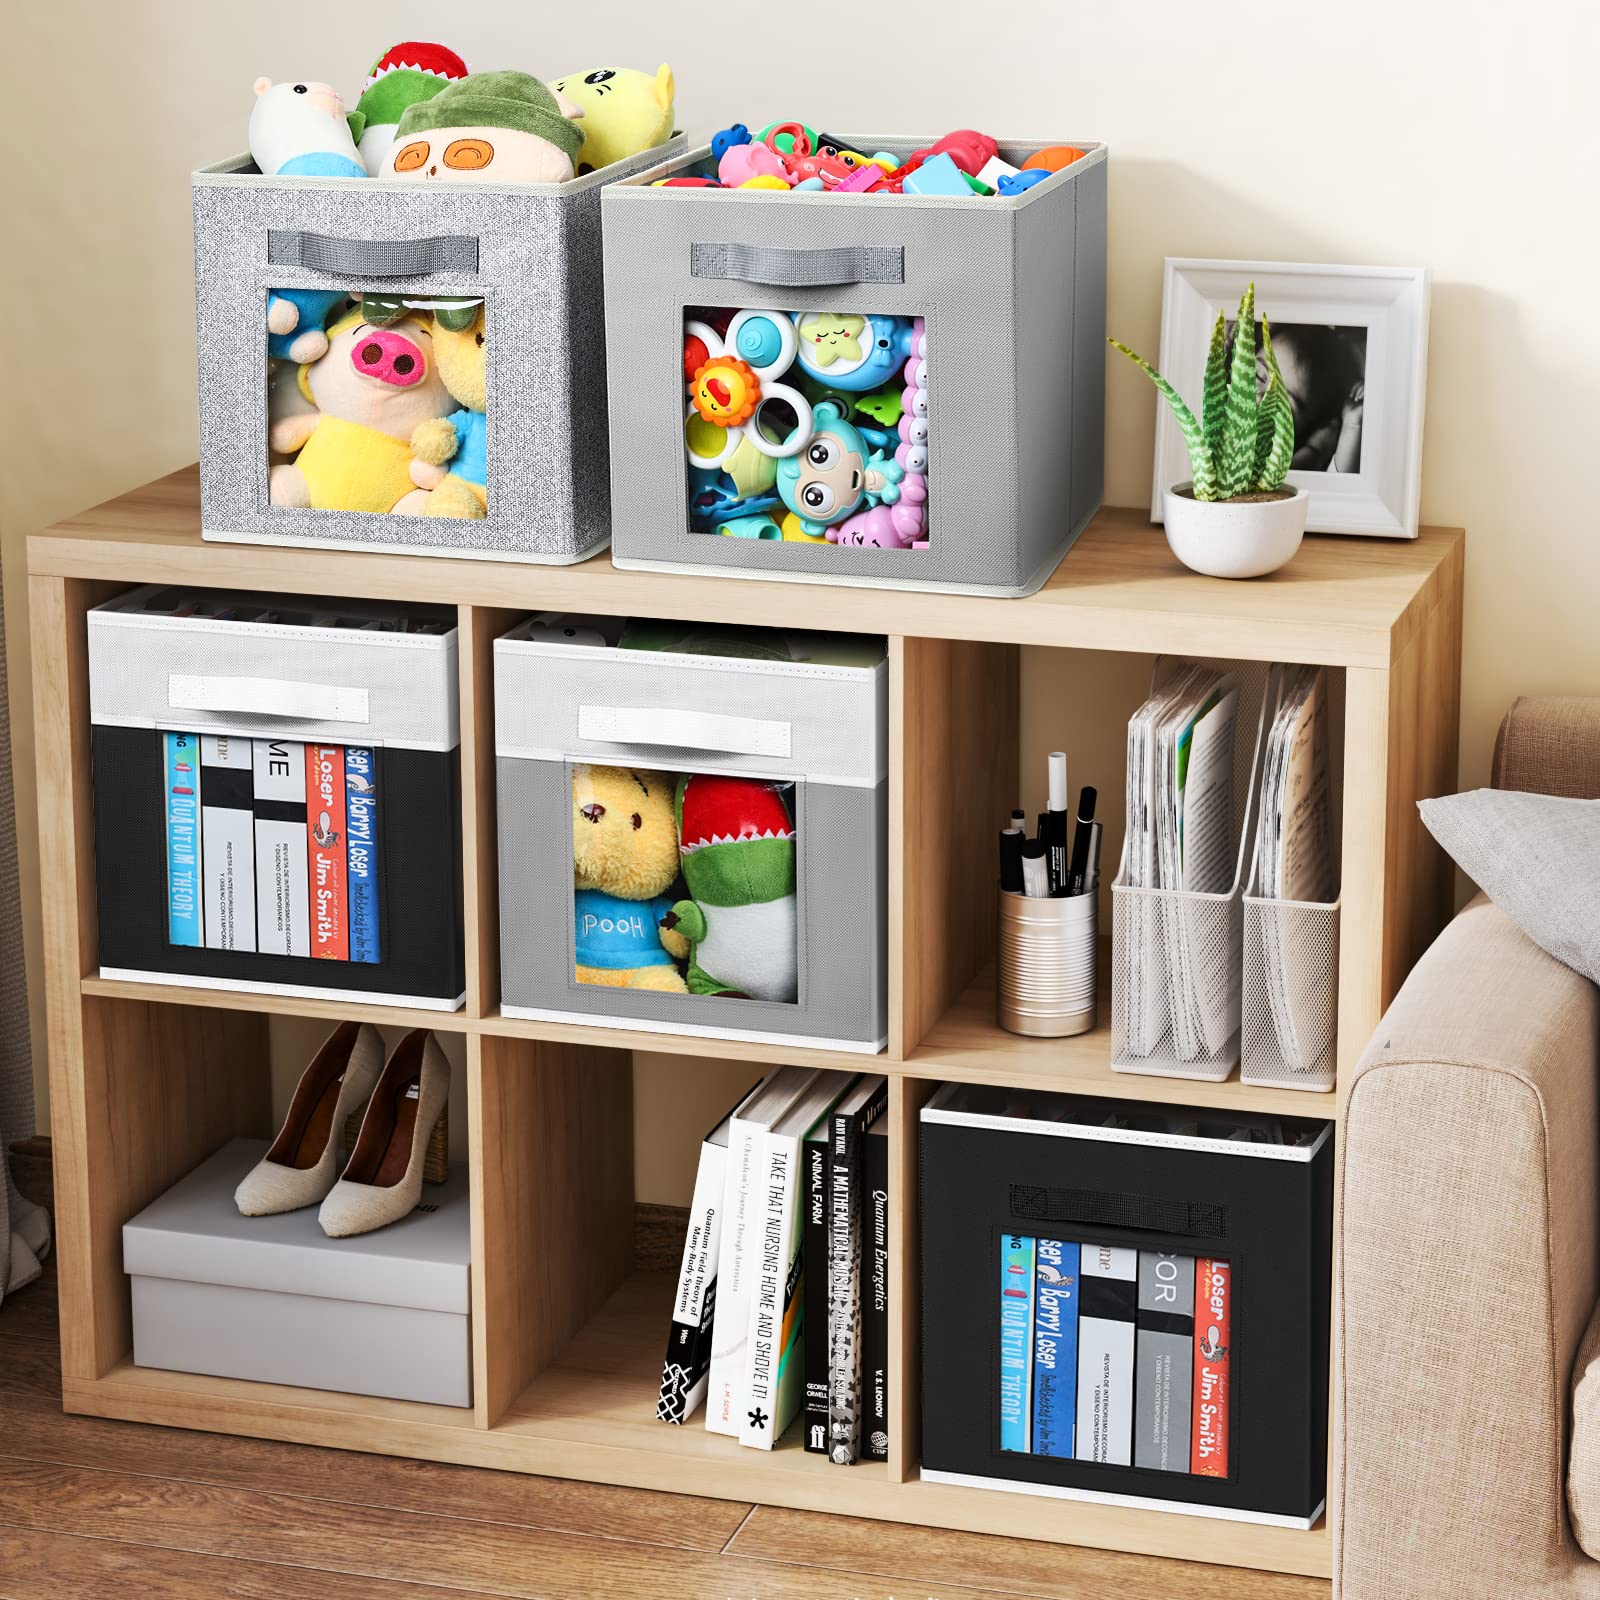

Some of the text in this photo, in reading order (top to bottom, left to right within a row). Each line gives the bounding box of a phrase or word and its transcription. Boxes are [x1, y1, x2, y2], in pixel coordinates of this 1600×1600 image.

[269, 741, 289, 776] ME
[320, 749, 336, 806] Loser
[348, 797, 375, 839] Barry
[170, 798, 195, 919] QUANTUM THEORY
[316, 853, 331, 886] Jim
[349, 840, 371, 877] Loser
[317, 889, 333, 942] Smith
[836, 1118, 846, 1155] RAVI VAKIL
[737, 1191, 747, 1219] Journey
[813, 1150, 822, 1224] ANIMAL FARM
[833, 1176, 848, 1257] MATHEMATICAL
[735, 1223, 745, 1252] Through
[872, 1190, 887, 1311] Quantum Energetics
[680, 1227, 701, 1313] Many-Body Systems
[690, 1209, 714, 1317] Quantum Field Theory of
[753, 1152, 787, 1399] TAKE THAT NURSING HOME AND SHOVE IT!
[833, 1261, 848, 1301] MOSAIC
[1036, 1239, 1070, 1369] ser Barry Loser
[1210, 1262, 1229, 1320] Loser
[680, 1329, 688, 1344] Wen
[835, 1308, 845, 1342] PATTERNS
[671, 1369, 680, 1394] OXFORD
[1001, 1301, 1028, 1424] QUANTUM THEORY
[807, 1383, 828, 1391] GEORGE
[807, 1391, 828, 1399] ORWELL
[836, 1382, 845, 1409] SOLVING
[875, 1386, 883, 1418] LEONOV
[1104, 1380, 1109, 1388] DE
[1201, 1367, 1217, 1399] Jim
[1199, 1404, 1217, 1457] Smith
